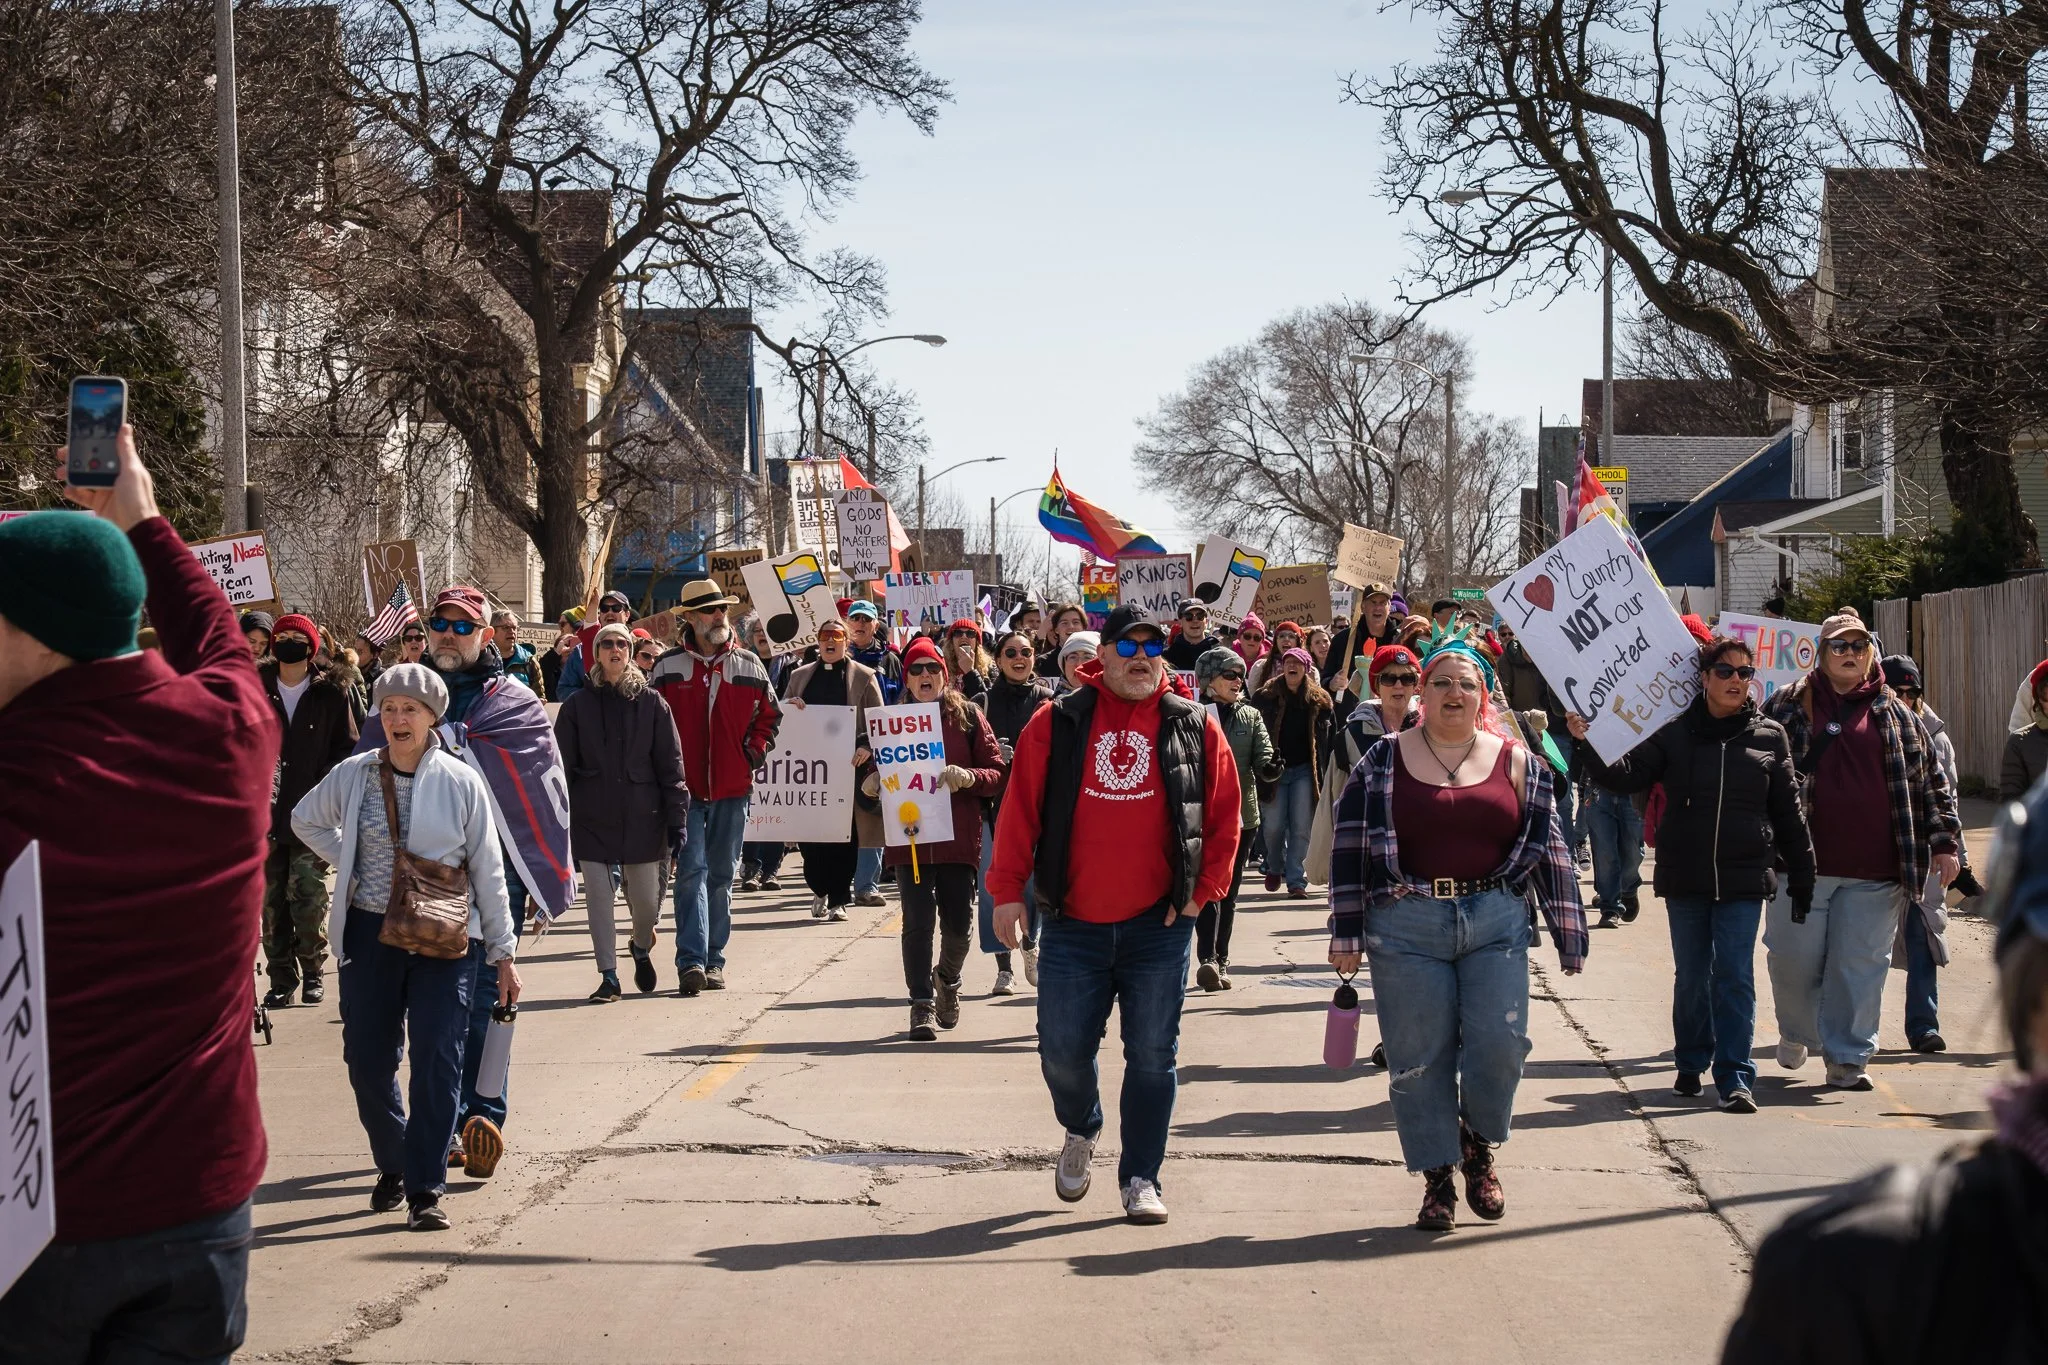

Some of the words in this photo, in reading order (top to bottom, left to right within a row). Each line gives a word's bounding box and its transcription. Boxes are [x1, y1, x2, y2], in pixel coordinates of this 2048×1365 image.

[848, 490, 867, 501] NO
[846, 507, 882, 522] GODS
[855, 523, 872, 536] NO
[841, 535, 888, 549] MASTERS
[232, 541, 265, 563] Nazis
[368, 544, 405, 574] NO
[856, 548, 873, 560] NO
[853, 560, 878, 576] KING
[1120, 569, 1133, 587] NO
[1136, 561, 1187, 584] KINGS
[216, 575, 253, 591] ican
[885, 571, 952, 588] LIBERTY
[1457, 590, 1479, 598] Walnut
[1502, 580, 1536, 629] I
[1565, 549, 1633, 600] Country
[1142, 591, 1182, 612] WAR
[887, 609, 913, 627] FOR
[1559, 592, 1613, 654] NOT
[1614, 591, 1644, 624] our
[517, 628, 557, 641] EMPATHY
[772, 634, 818, 653] SING
[1728, 622, 1819, 671] THRO
[1564, 627, 1651, 722] Convicted
[1612, 671, 1675, 735] Felon
[1665, 652, 1684, 669] in
[869, 714, 933, 738] FLUSH
[1084, 787, 1100, 797] The
[1099, 792, 1127, 800] POSSE
[1126, 789, 1155, 801] Project
